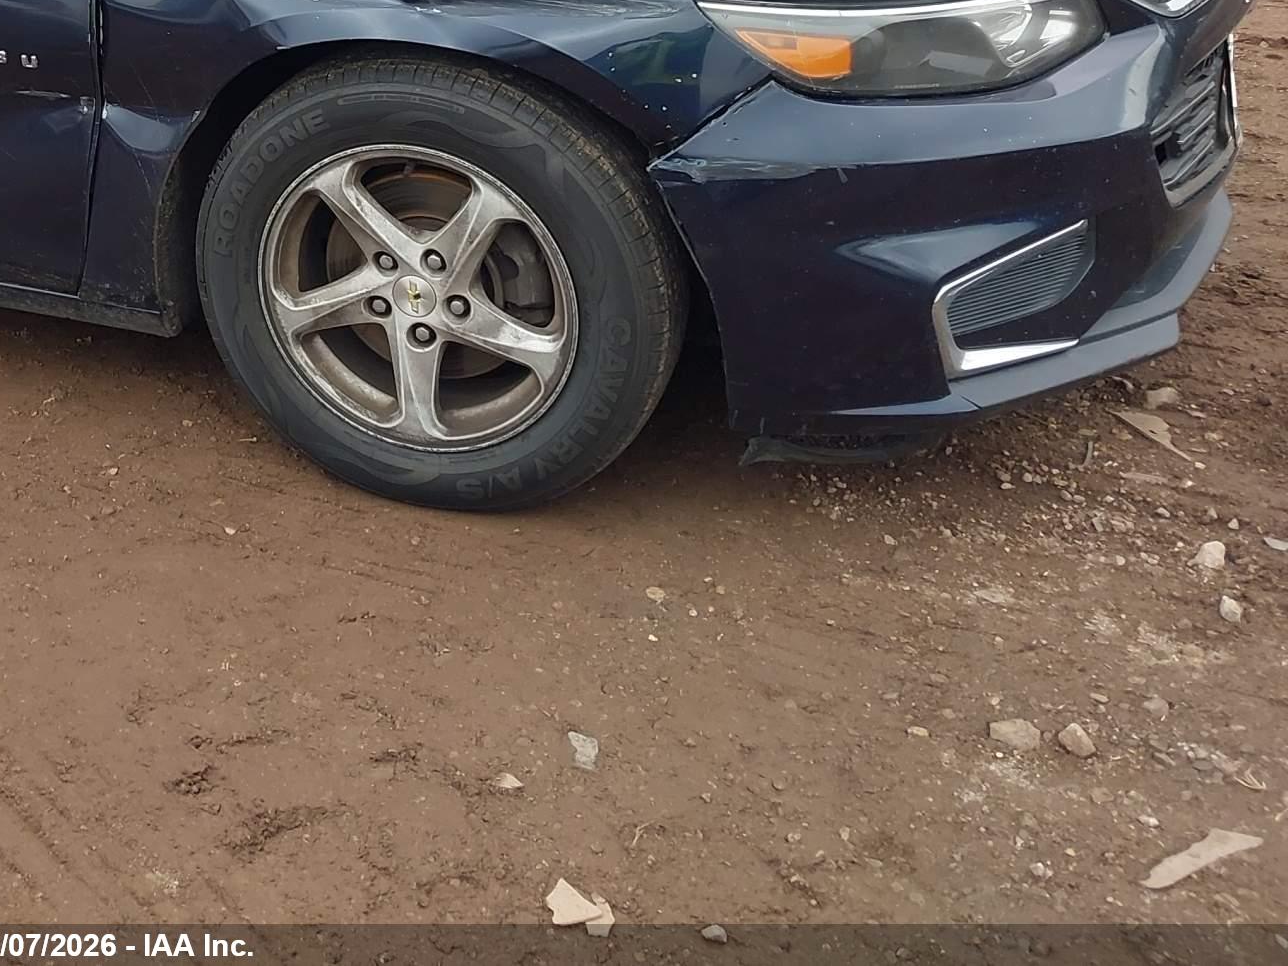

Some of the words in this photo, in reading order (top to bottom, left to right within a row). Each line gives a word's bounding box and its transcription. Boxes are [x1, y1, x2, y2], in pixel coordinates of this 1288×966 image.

[213, 106, 331, 259] ROADONE
[534, 317, 632, 481] CAVALRY
[455, 466, 524, 500] A/S
